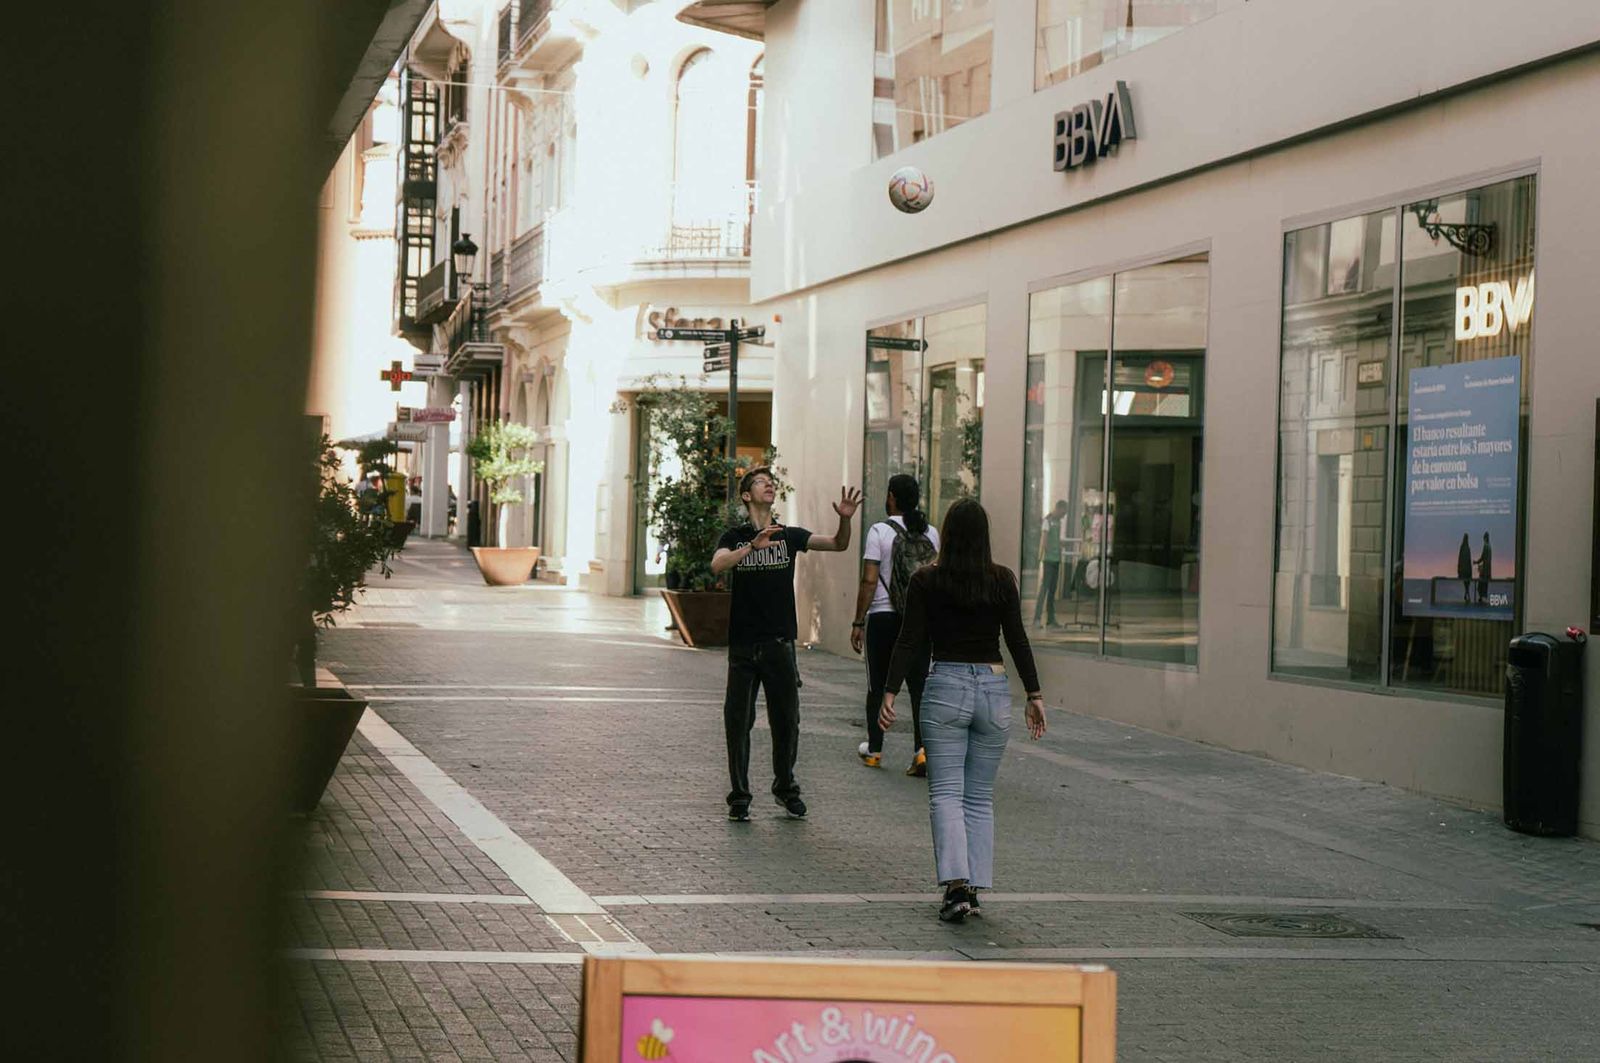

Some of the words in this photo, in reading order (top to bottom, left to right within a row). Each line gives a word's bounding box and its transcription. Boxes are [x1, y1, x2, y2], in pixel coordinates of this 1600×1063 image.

[1053, 80, 1136, 172] BBVA
[1413, 426, 1421, 441] El
[1478, 440, 1512, 457] mayores
[1412, 460, 1421, 475] de
[1422, 459, 1430, 474] la
[1457, 473, 1479, 490] bolsa
[1489, 594, 1508, 606] BBVA
[821, 1007, 851, 1044] &
